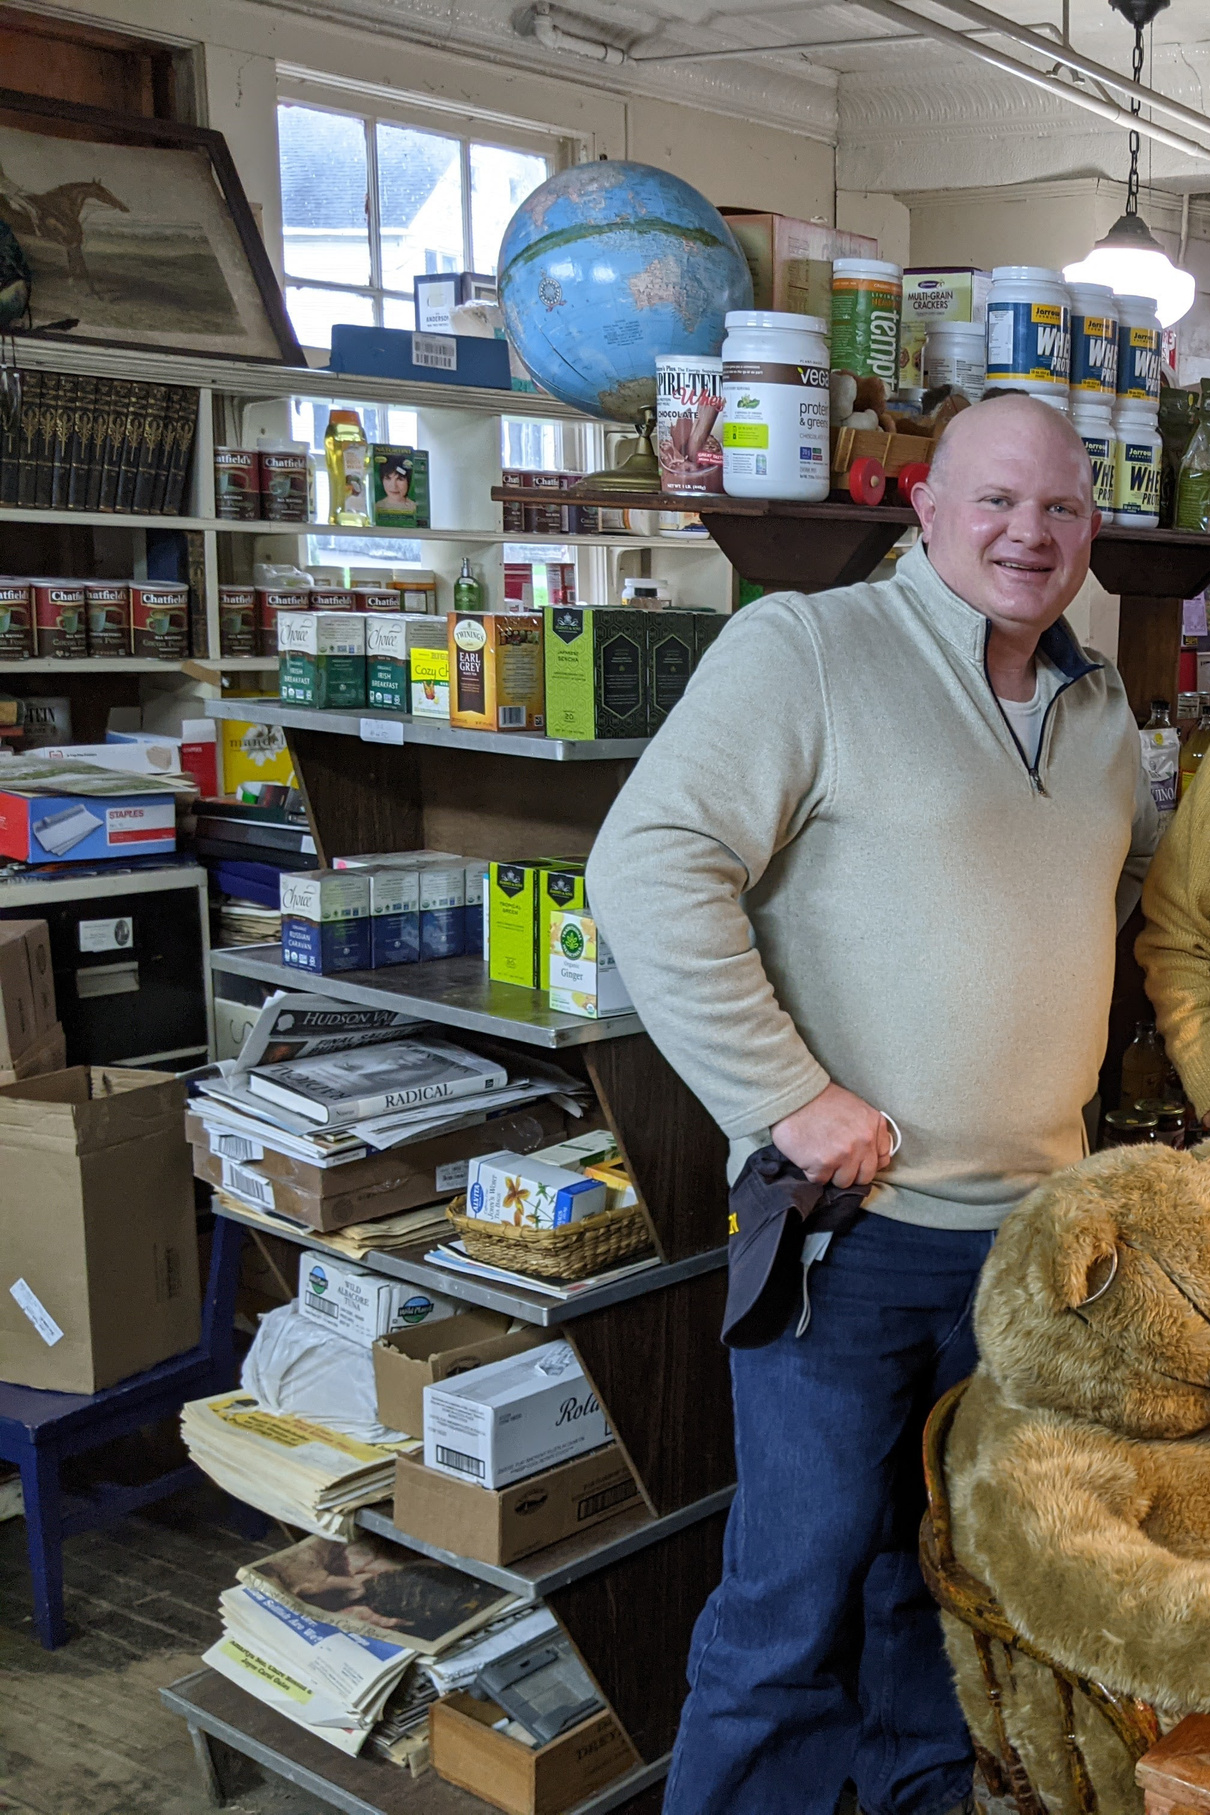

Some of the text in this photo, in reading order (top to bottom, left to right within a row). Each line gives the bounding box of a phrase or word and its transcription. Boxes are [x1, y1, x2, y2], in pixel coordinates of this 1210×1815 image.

[908, 291, 953, 301] MULTI-GRAIN
[913, 301, 948, 310] CRACKERS
[1036, 306, 1061, 317] Jarrow
[673, 387, 727, 412] Whey
[658, 410, 700, 420] CHOCOLATE
[800, 418, 806, 426] &
[1128, 446, 1152, 457] Jarrow
[456, 630, 484, 642] TWININGS
[459, 652, 480, 663] EARL
[290, 667, 303, 675] IRISH
[415, 664, 436, 679] Cozy
[459, 662, 480, 672] GREY
[284, 675, 310, 684] BREAKFAST
[378, 672, 391, 680] IRISH
[371, 680, 398, 689] BREAKFAST
[109, 809, 144, 819] STAPLES
[288, 939, 312, 950] CARAVAN
[561, 968, 584, 982] Ginger
[303, 1012, 370, 1025] HUDSON
[385, 1083, 453, 1108] RADICAL
[345, 1280, 361, 1293] WILD
[338, 1287, 369, 1306] ALBACORE
[344, 1297, 361, 1312] TUNA
[241, 1657, 257, 1671] Joyce
